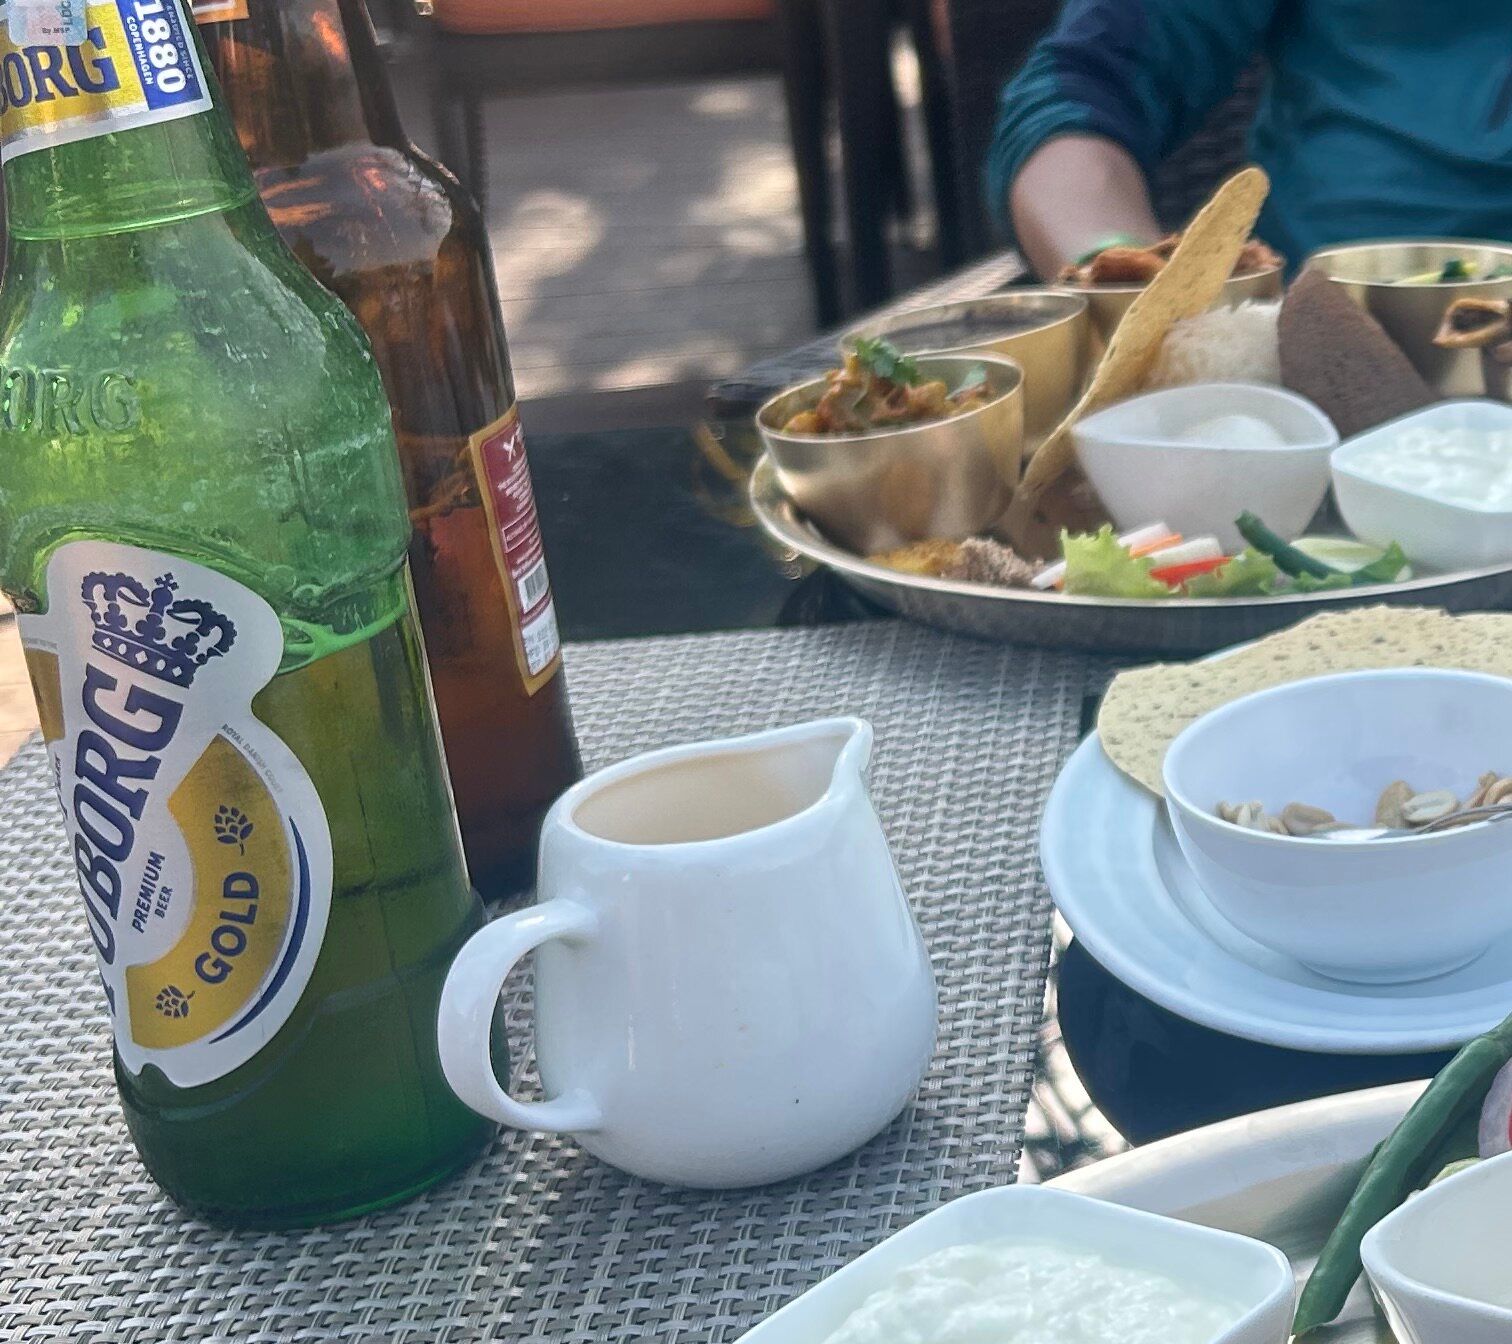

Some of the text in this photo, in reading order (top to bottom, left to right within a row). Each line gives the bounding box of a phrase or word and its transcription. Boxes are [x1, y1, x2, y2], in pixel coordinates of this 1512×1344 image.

[126, 15, 154, 86] COPENHAGEN
[222, 723, 245, 745] ROYAL
[132, 851, 165, 934] PREMIUM
[154, 886, 174, 919] BEER
[195, 871, 260, 985] GOLD
